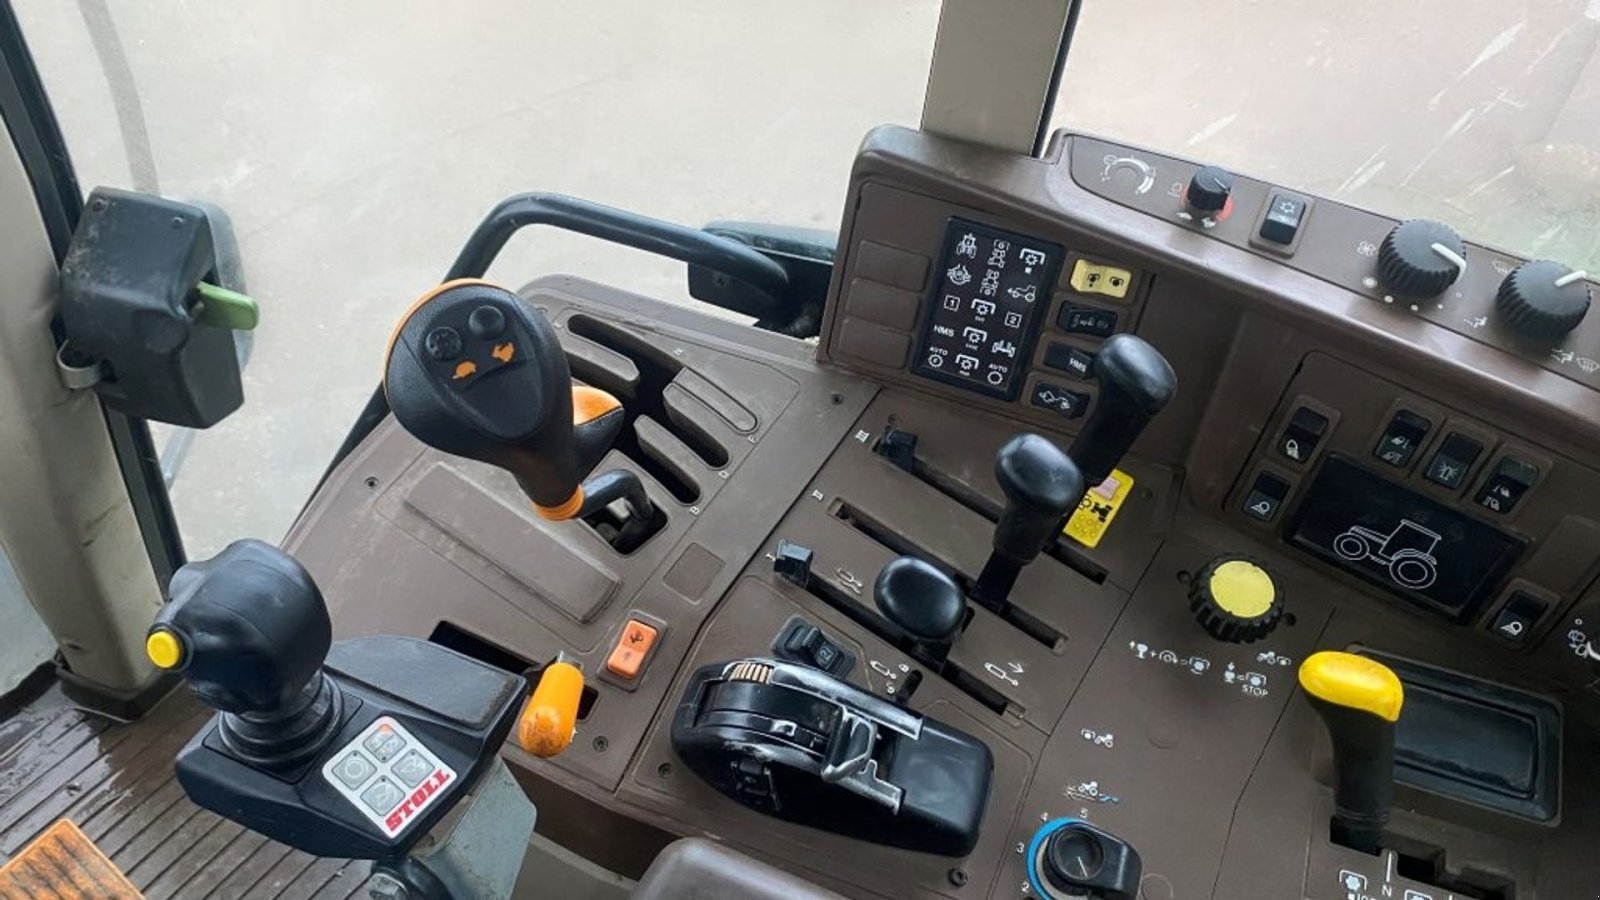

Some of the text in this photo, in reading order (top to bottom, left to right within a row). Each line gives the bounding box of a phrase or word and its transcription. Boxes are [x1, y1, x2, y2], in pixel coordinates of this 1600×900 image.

[929, 346, 949, 356] AUTO
[988, 363, 1008, 373] AUTO
[1242, 684, 1269, 698] STOP
[385, 769, 451, 833] STOLL
[1016, 842, 1025, 853] 3
[1021, 881, 1030, 893] 2
[1382, 883, 1392, 897] N
